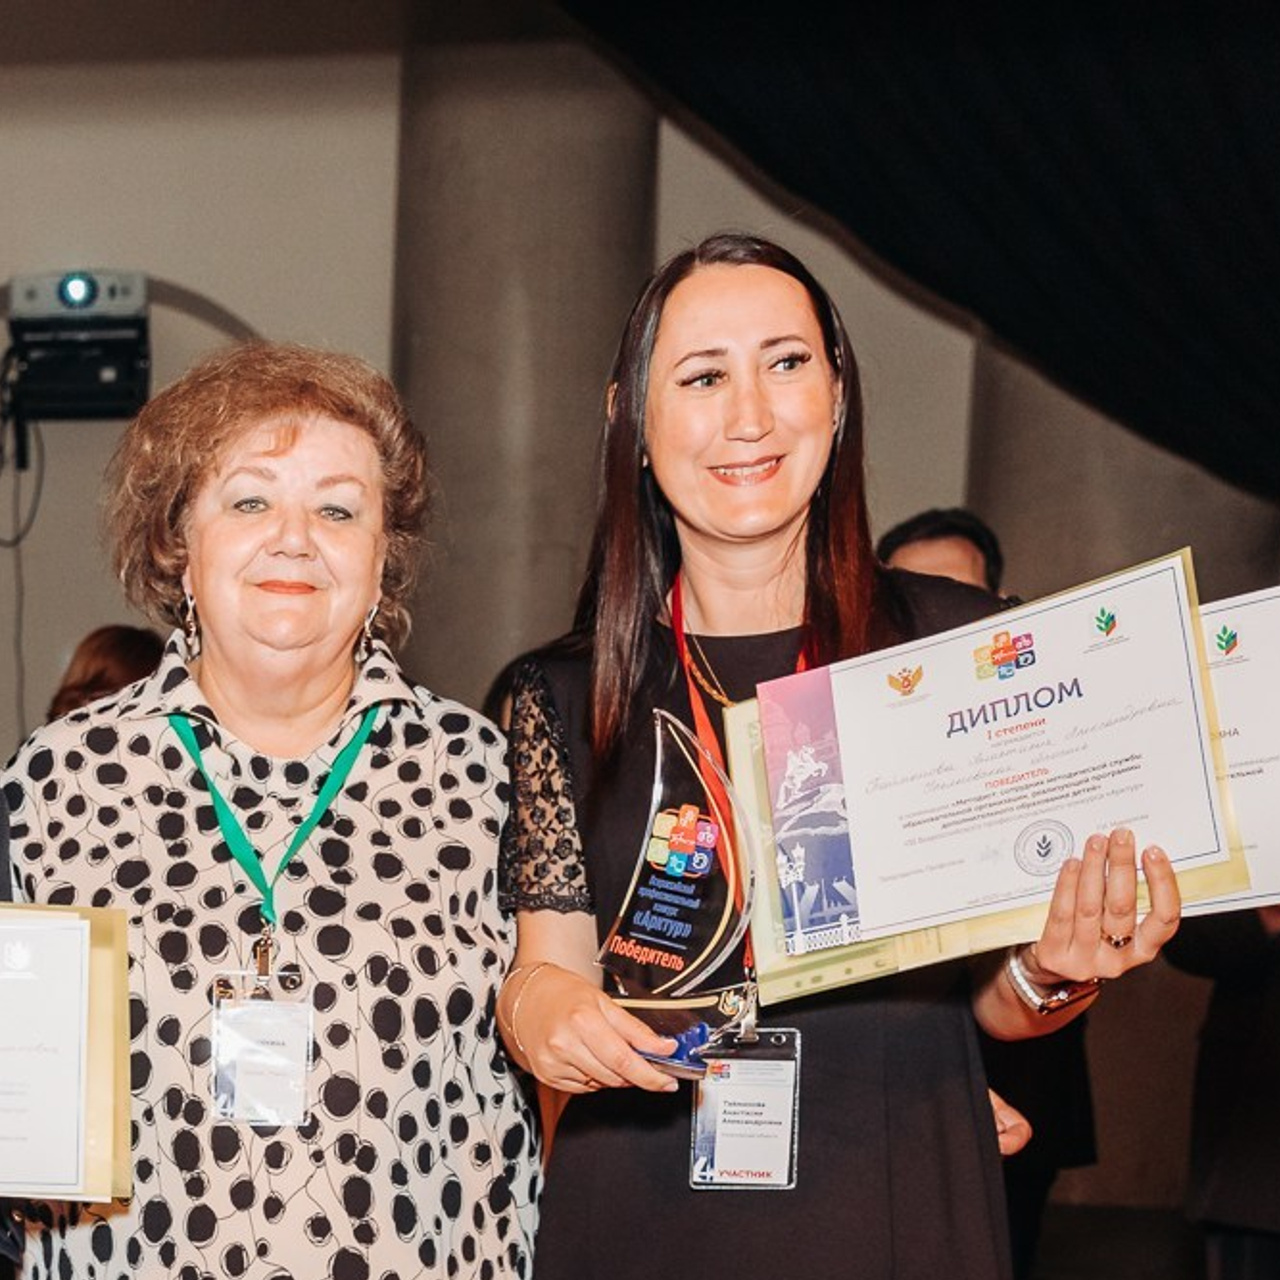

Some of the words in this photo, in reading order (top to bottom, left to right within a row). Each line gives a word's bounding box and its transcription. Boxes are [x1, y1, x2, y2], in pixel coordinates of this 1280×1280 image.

[946, 677, 1083, 739] ДИПЛОМ
[995, 718, 1046, 738] степени
[984, 767, 1050, 789] ПОБЕДИТЕЛЬ
[633, 910, 693, 938] «Арктур»
[610, 935, 685, 971] Победитель
[720, 1169, 773, 1179] УЧАСТНИК
